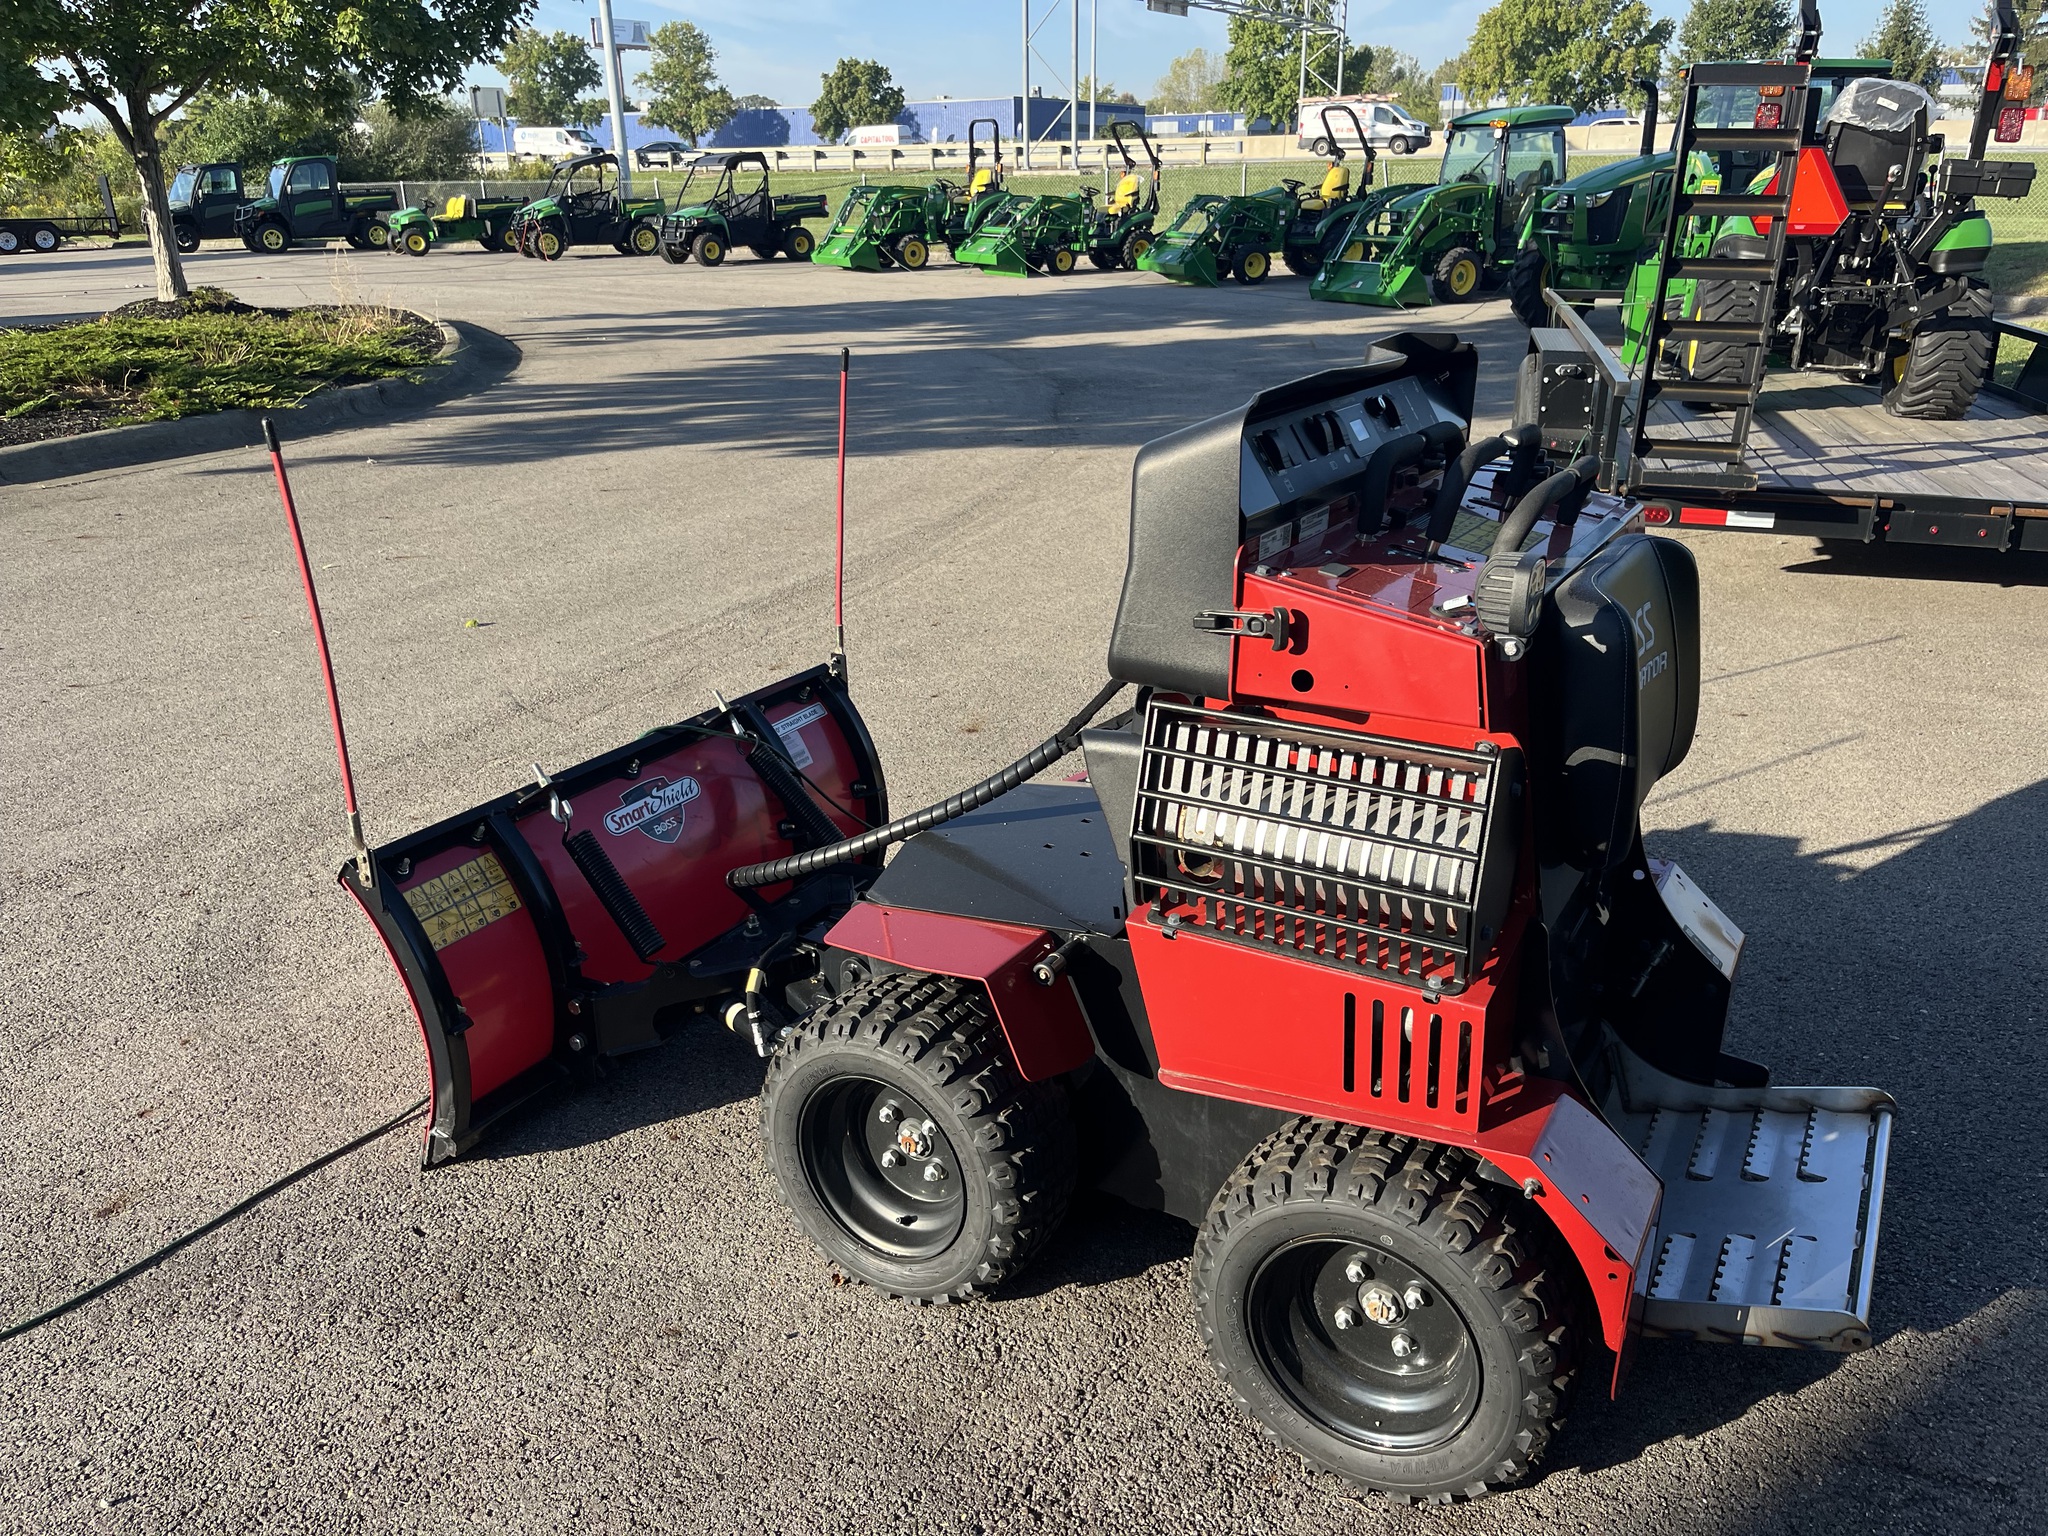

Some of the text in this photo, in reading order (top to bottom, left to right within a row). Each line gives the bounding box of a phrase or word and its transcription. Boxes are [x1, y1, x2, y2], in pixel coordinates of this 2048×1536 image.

[860, 136, 881, 144] CAPITAL
[780, 716, 803, 731] STRAIGHT
[803, 708, 819, 721] BLADE
[653, 816, 678, 836] BOSS
[1224, 1303, 1299, 1430] TERRA TRAC
